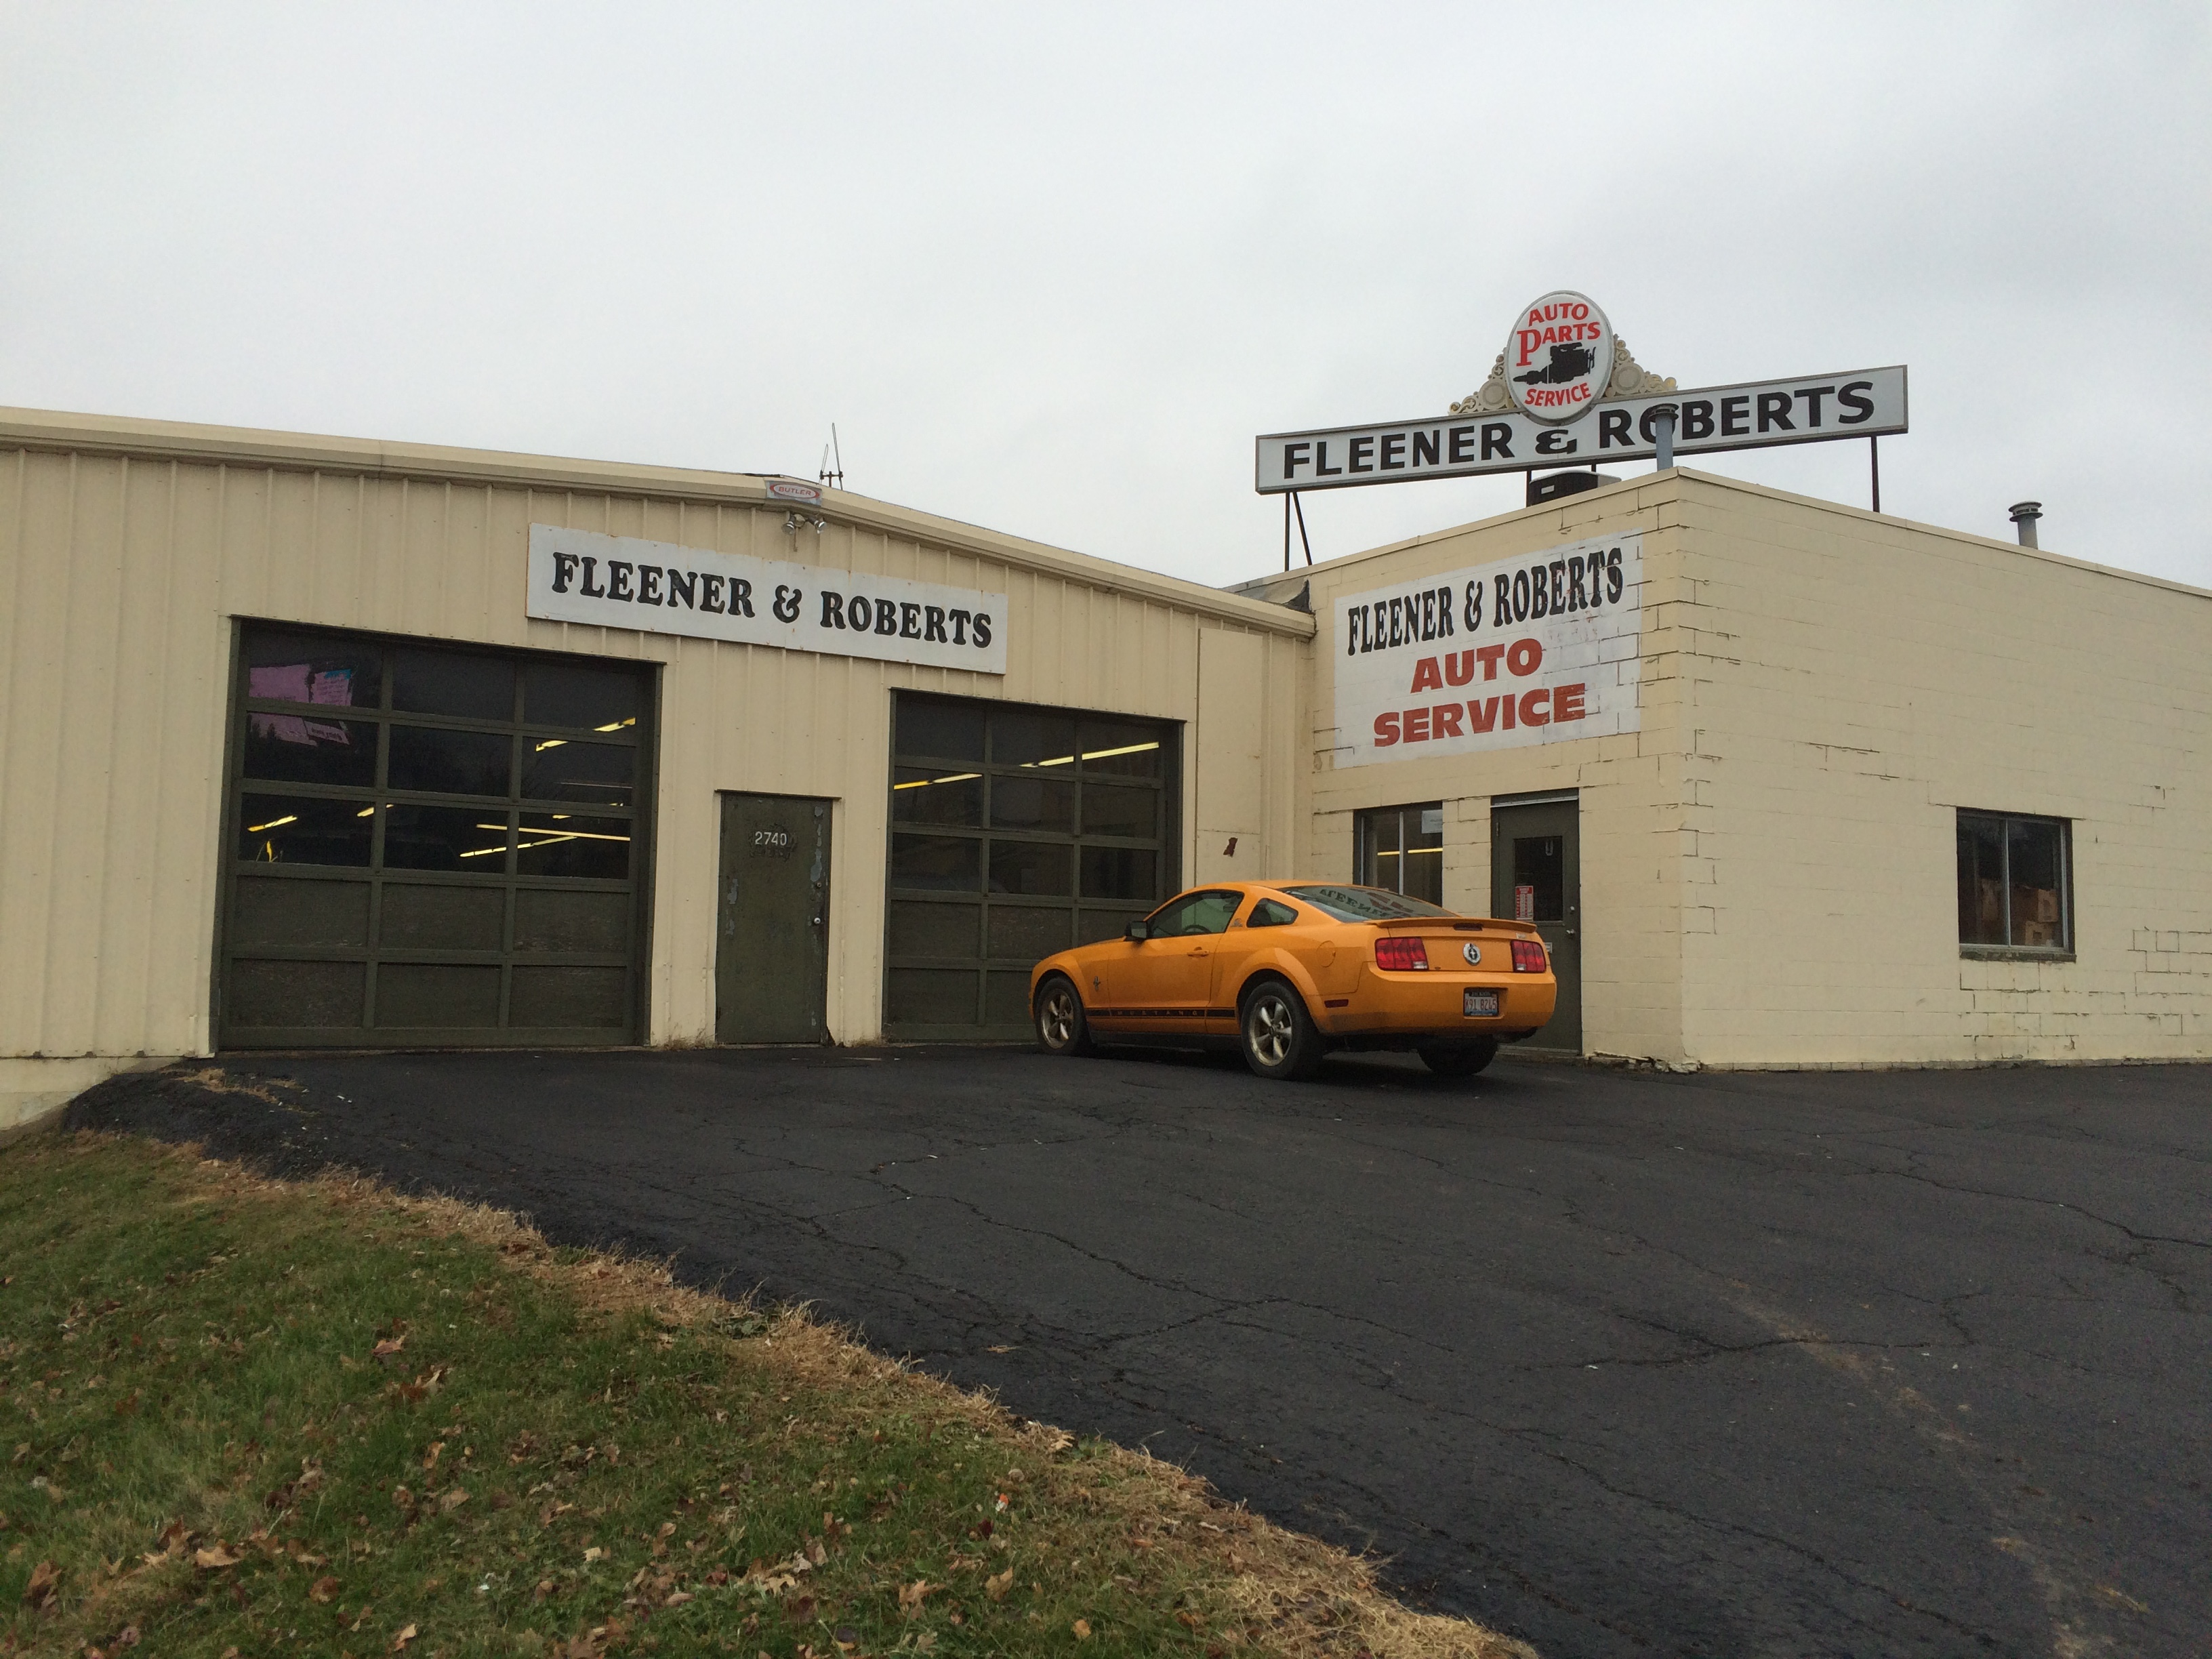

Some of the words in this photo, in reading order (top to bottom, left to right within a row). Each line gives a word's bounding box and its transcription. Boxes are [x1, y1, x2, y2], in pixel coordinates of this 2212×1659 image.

[1528, 302, 1589, 327] AUTO
[1516, 321, 1601, 367] PARTS
[1524, 382, 1591, 407] SERVICE
[1284, 422, 1515, 479] FLEENER
[1534, 428, 1578, 455] &
[778, 486, 812, 496] BUTLER
[552, 552, 756, 618] FLEENER
[772, 584, 802, 623] &
[820, 590, 991, 649] ROBERTS
[1347, 586, 1454, 656] FLEENER
[1464, 580, 1483, 632] &
[1493, 548, 1624, 628] ROBERTS
[1410, 638, 1543, 694] AUTO
[1374, 682, 1586, 747] SERVICE
[755, 831, 787, 846] 2740
